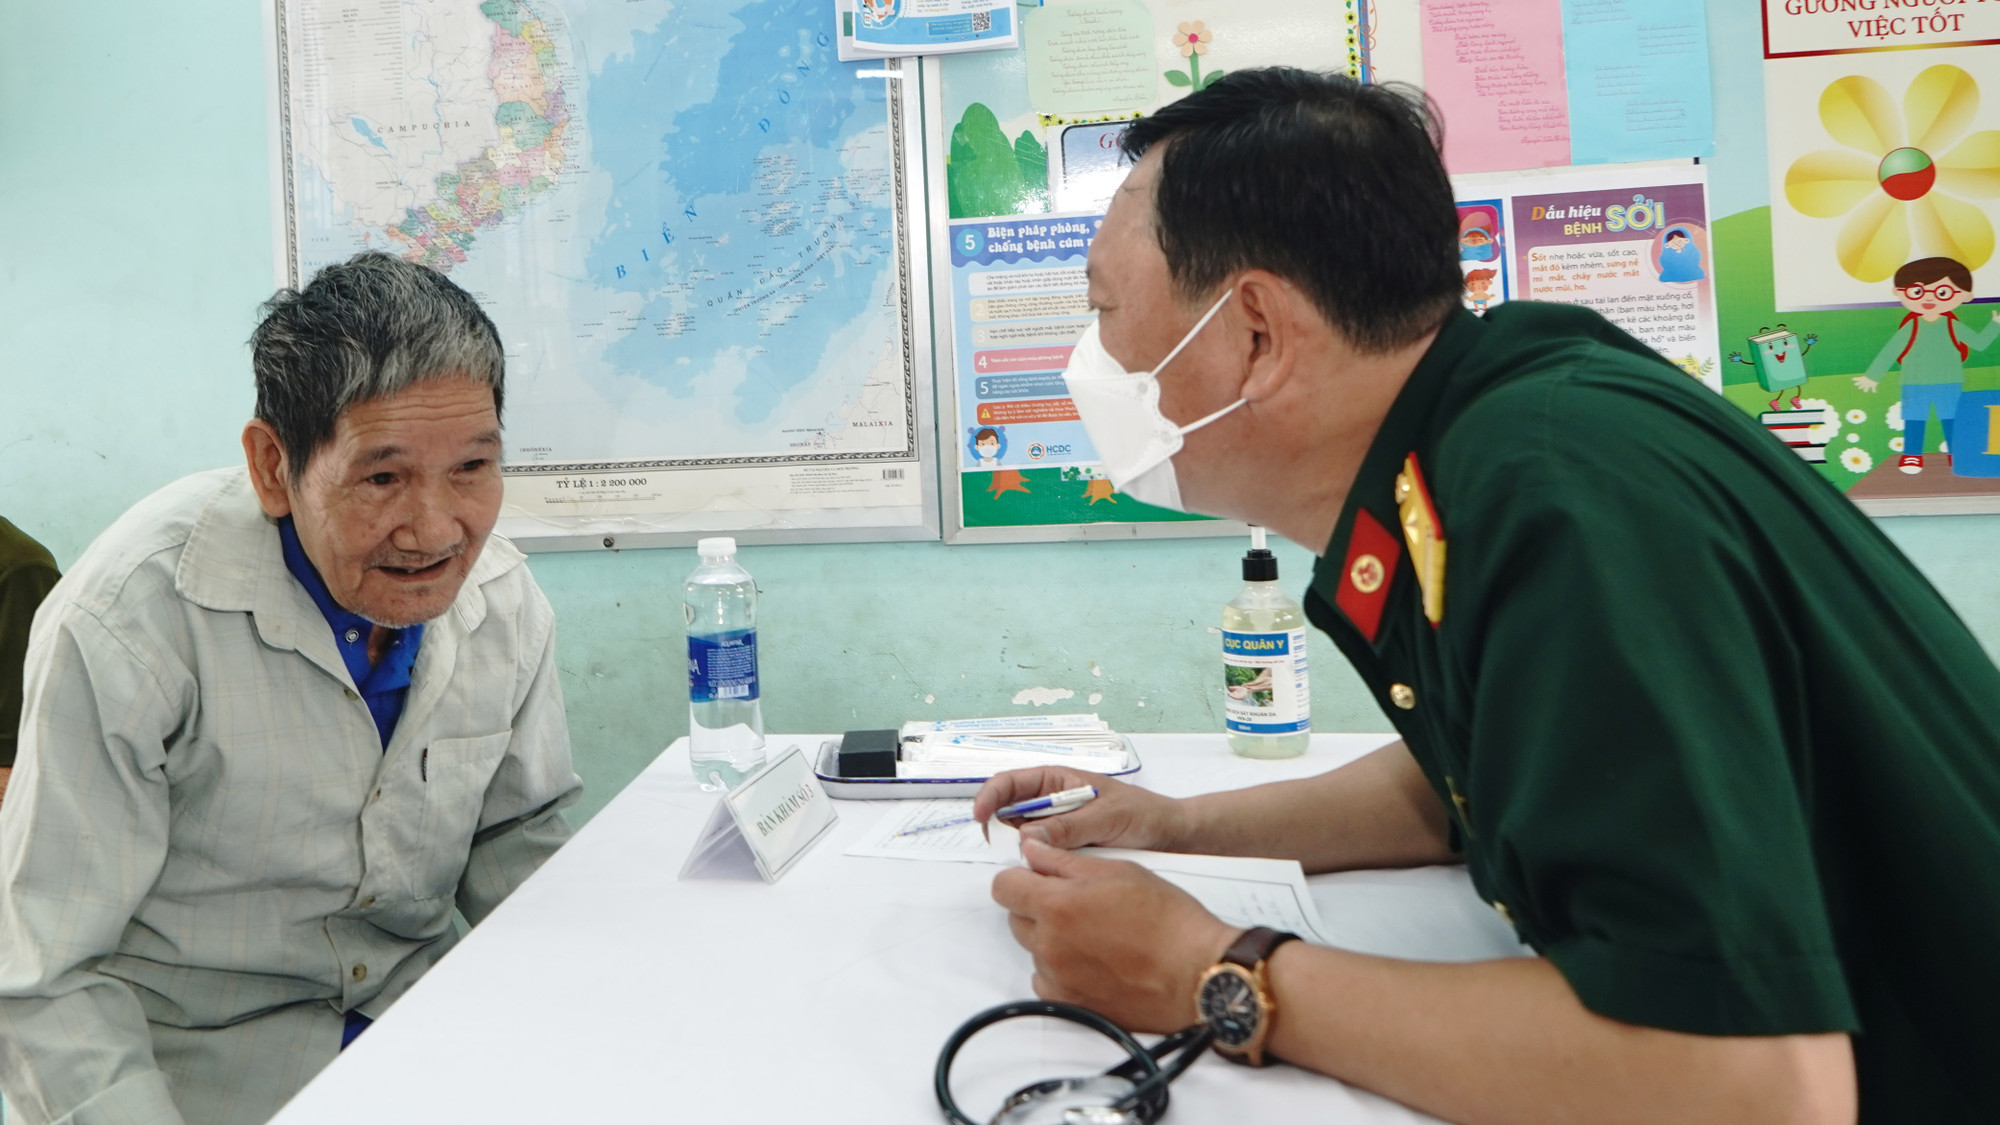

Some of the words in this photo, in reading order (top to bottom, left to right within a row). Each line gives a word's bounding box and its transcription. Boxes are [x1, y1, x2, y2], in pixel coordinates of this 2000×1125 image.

[1847, 15, 1906, 40] VIỆC
[1911, 7, 1965, 34] TỐT
[378, 120, 470, 133] CAMPUCHIA
[1531, 205, 1565, 220] Dấu
[1568, 205, 1601, 220] hiệu
[1564, 221, 1602, 237] BỆNH
[1605, 194, 1666, 232] SỞI
[987, 227, 1015, 239] Biện
[1018, 225, 1047, 238] pháp
[1050, 222, 1090, 236] phòng,
[965, 234, 976, 251] 5
[988, 240, 1023, 253] chống
[1026, 239, 1056, 252] bệnh
[1059, 238, 1084, 248] cúm
[1532, 253, 1547, 261] Sốt
[1656, 292, 1680, 301] xuống
[978, 356, 988, 368] 4
[980, 382, 989, 395] 5
[1046, 444, 1071, 453] HCDC
[1225, 638, 1241, 649] CỤC
[1243, 639, 1275, 650] QUÂN
[1276, 640, 1284, 649] Y
[757, 813, 777, 836] BÀN
[773, 795, 801, 823] KHÁM
